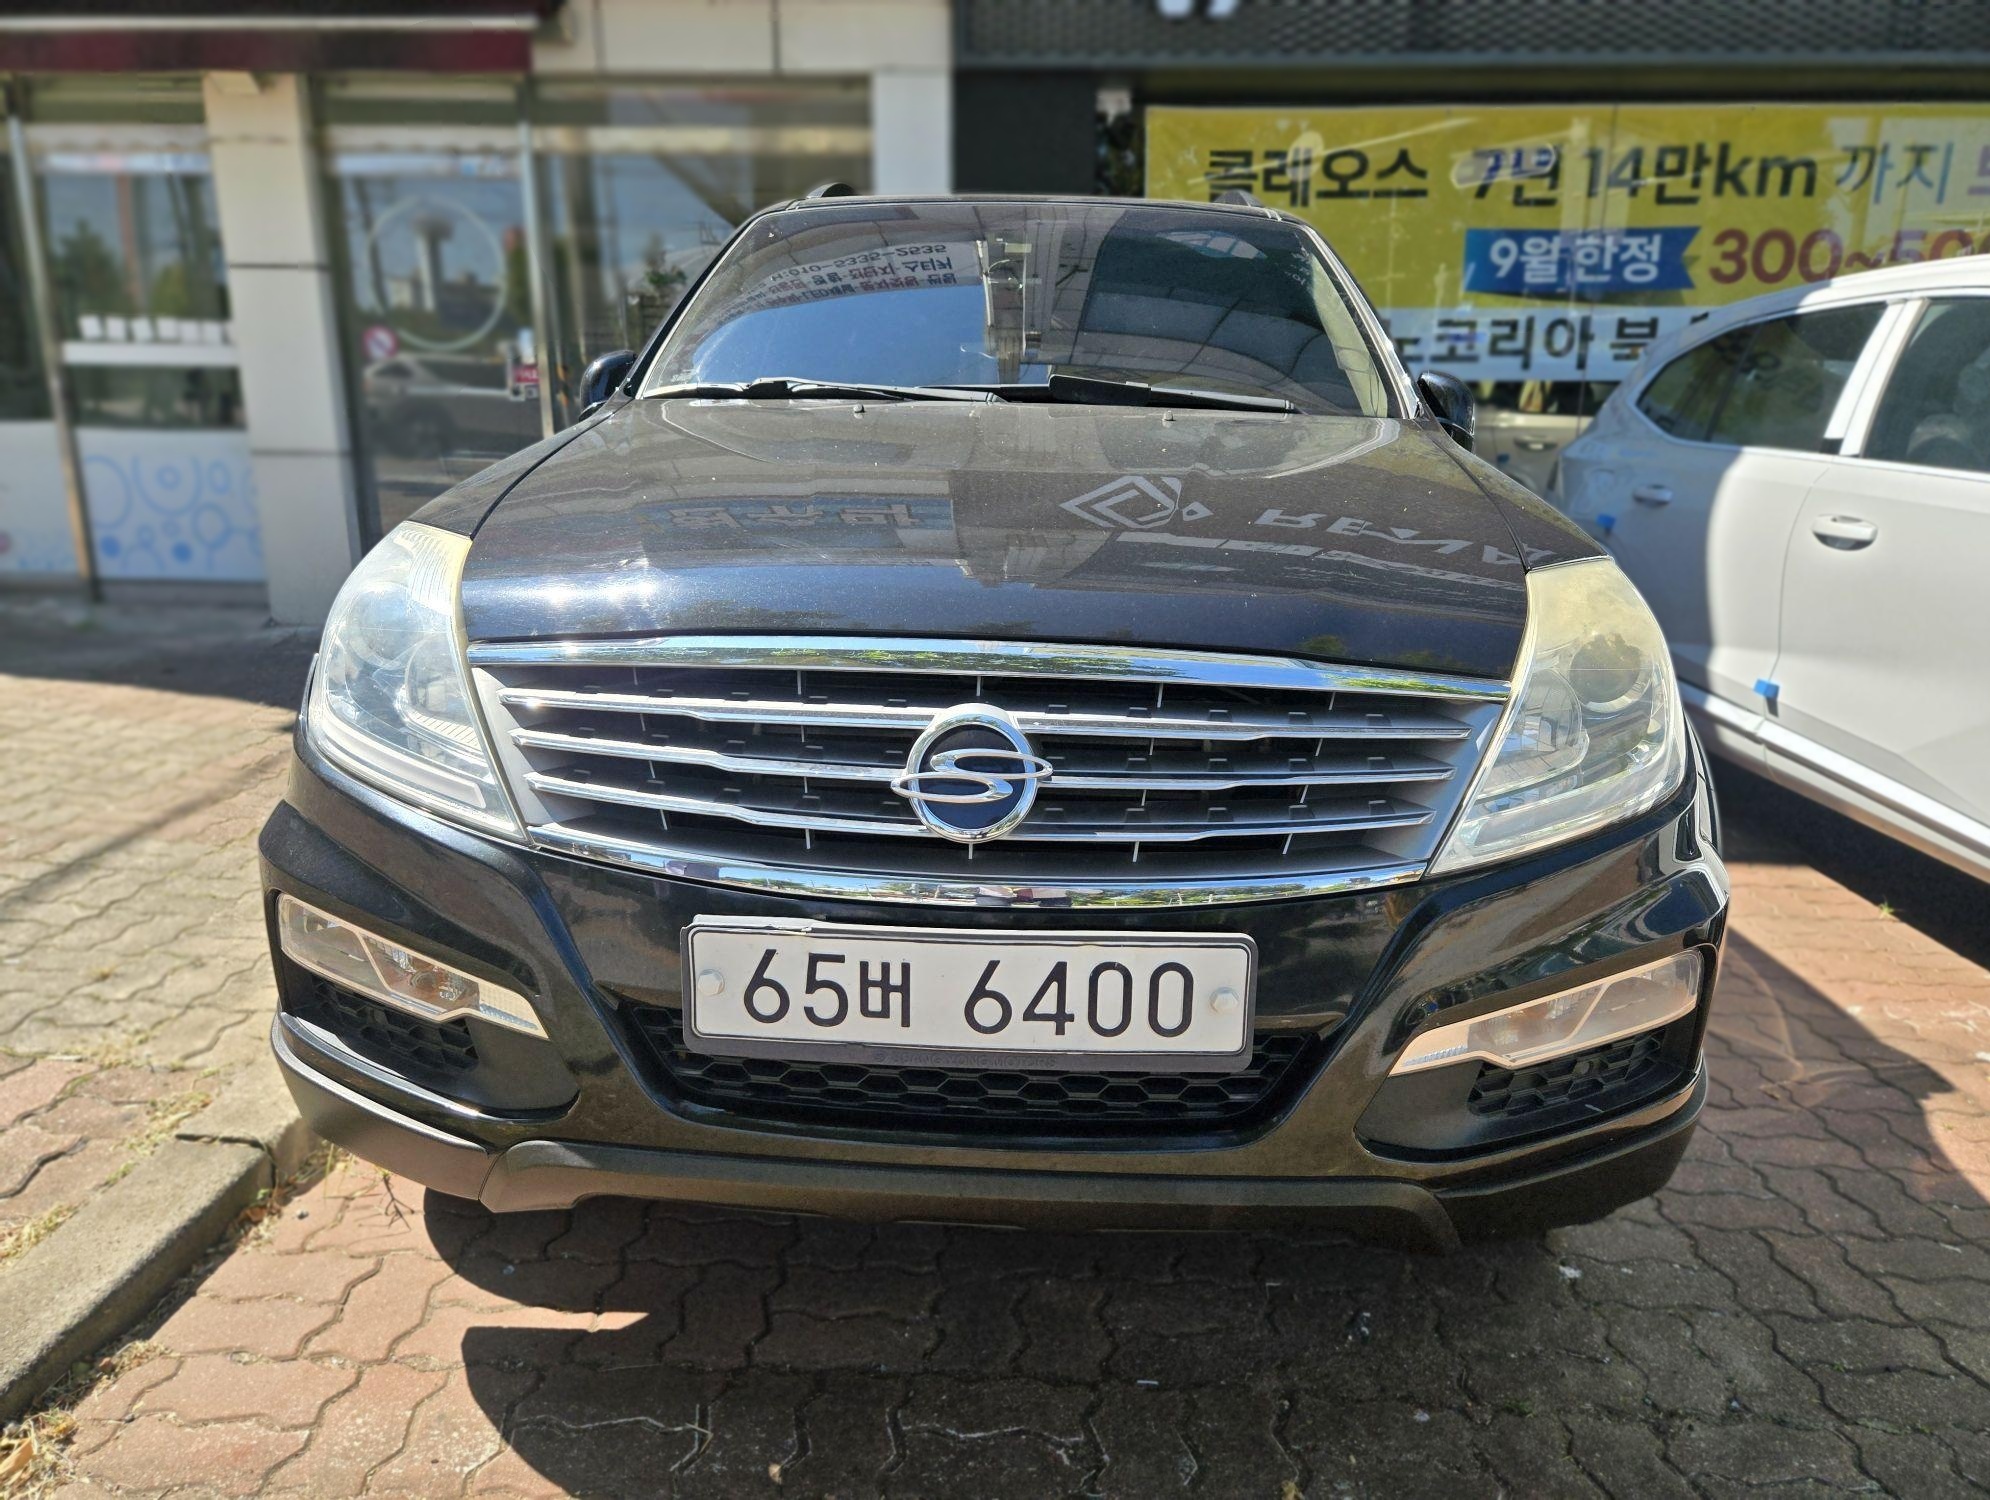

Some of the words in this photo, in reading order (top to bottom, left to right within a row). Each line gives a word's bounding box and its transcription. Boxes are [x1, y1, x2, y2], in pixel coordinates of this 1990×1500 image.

[1489, 236, 1561, 284] 9월
[1574, 234, 1662, 283] 한정
[743, 948, 911, 1028] 65버
[964, 960, 1194, 1038] 6400
